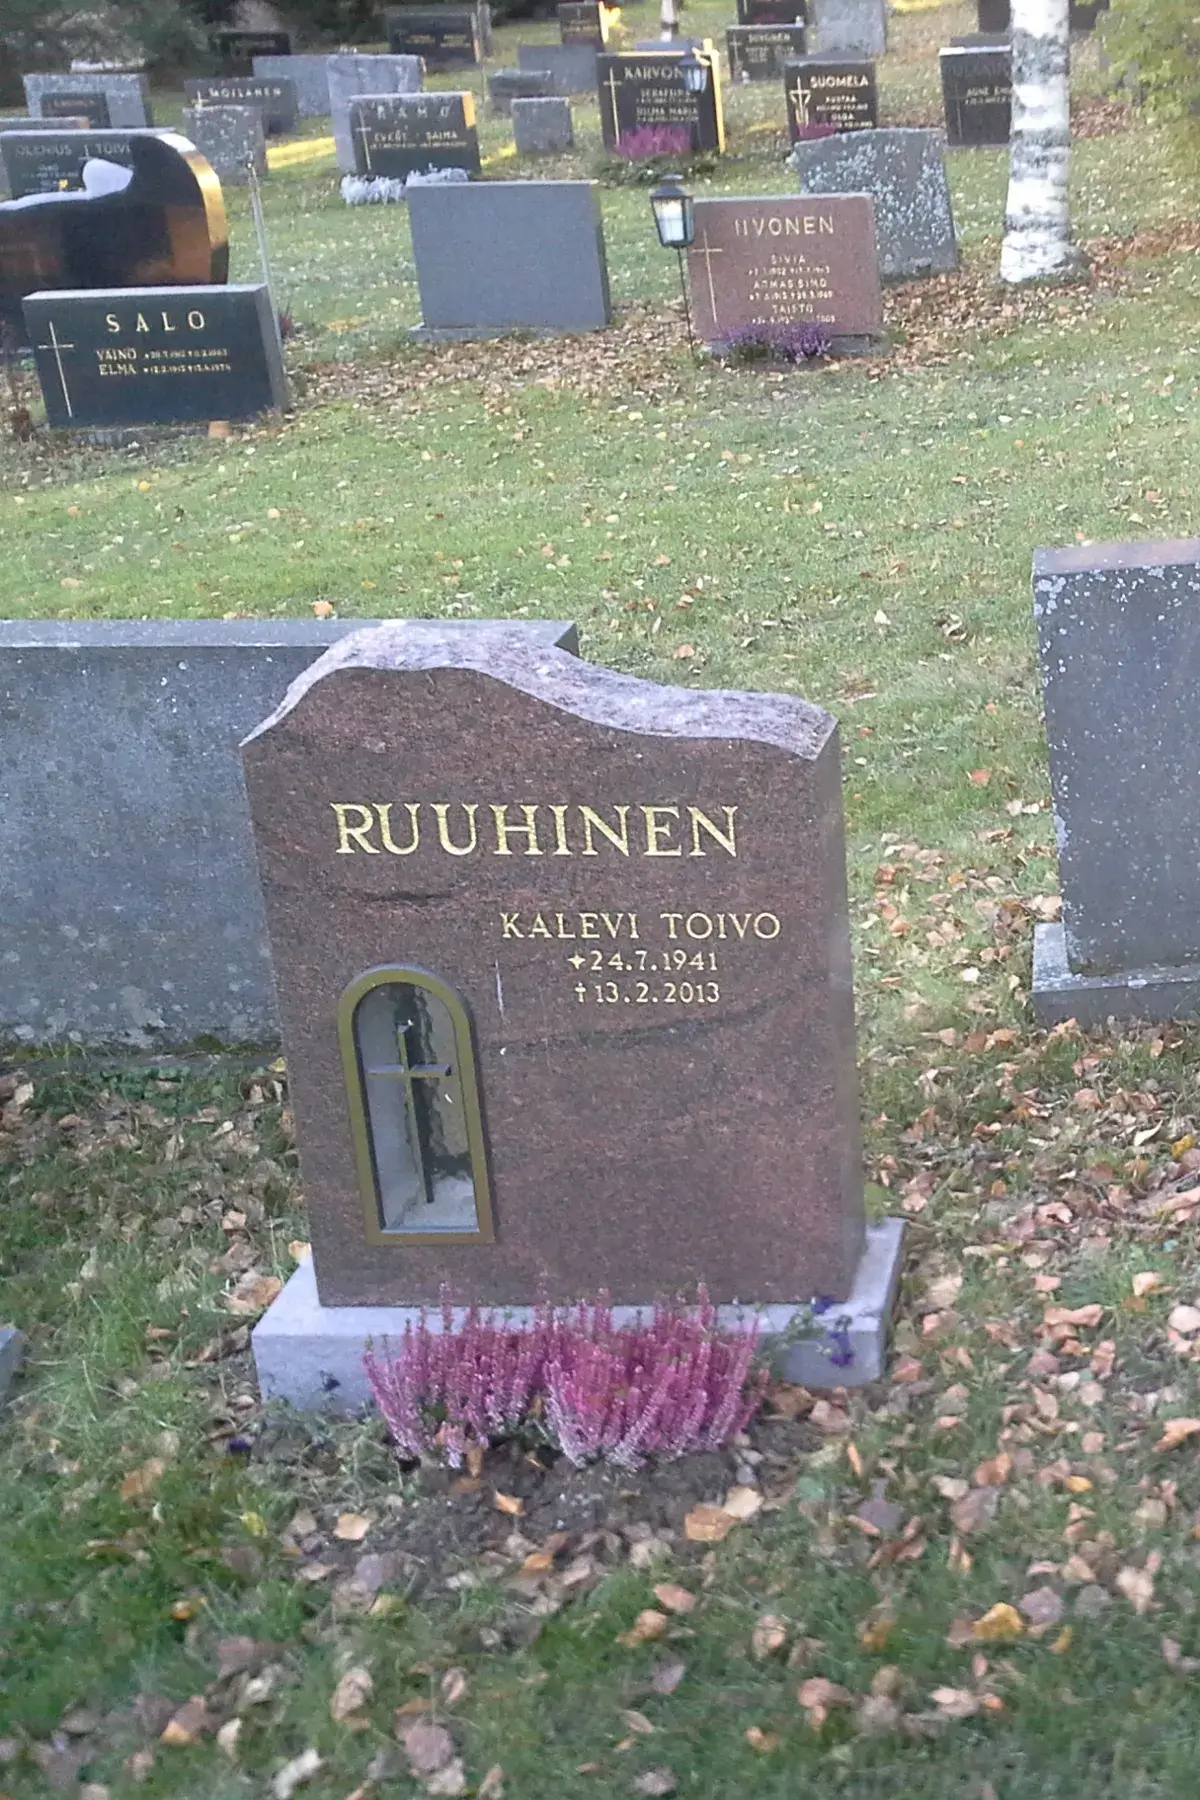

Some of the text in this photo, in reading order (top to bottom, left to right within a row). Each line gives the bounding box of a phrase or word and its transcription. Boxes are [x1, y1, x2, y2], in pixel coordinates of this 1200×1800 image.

[810, 75, 869, 89] SUOMELA
[734, 215, 834, 236] IIVONEN
[105, 310, 206, 333] SALO
[99, 364, 137, 376] ELMA
[330, 802, 739, 857] RUUHINEN
[501, 912, 782, 939] KALEVI TOIVO
[590, 950, 718, 972] 24.7.1941
[596, 982, 721, 1004] 13.2.2013
